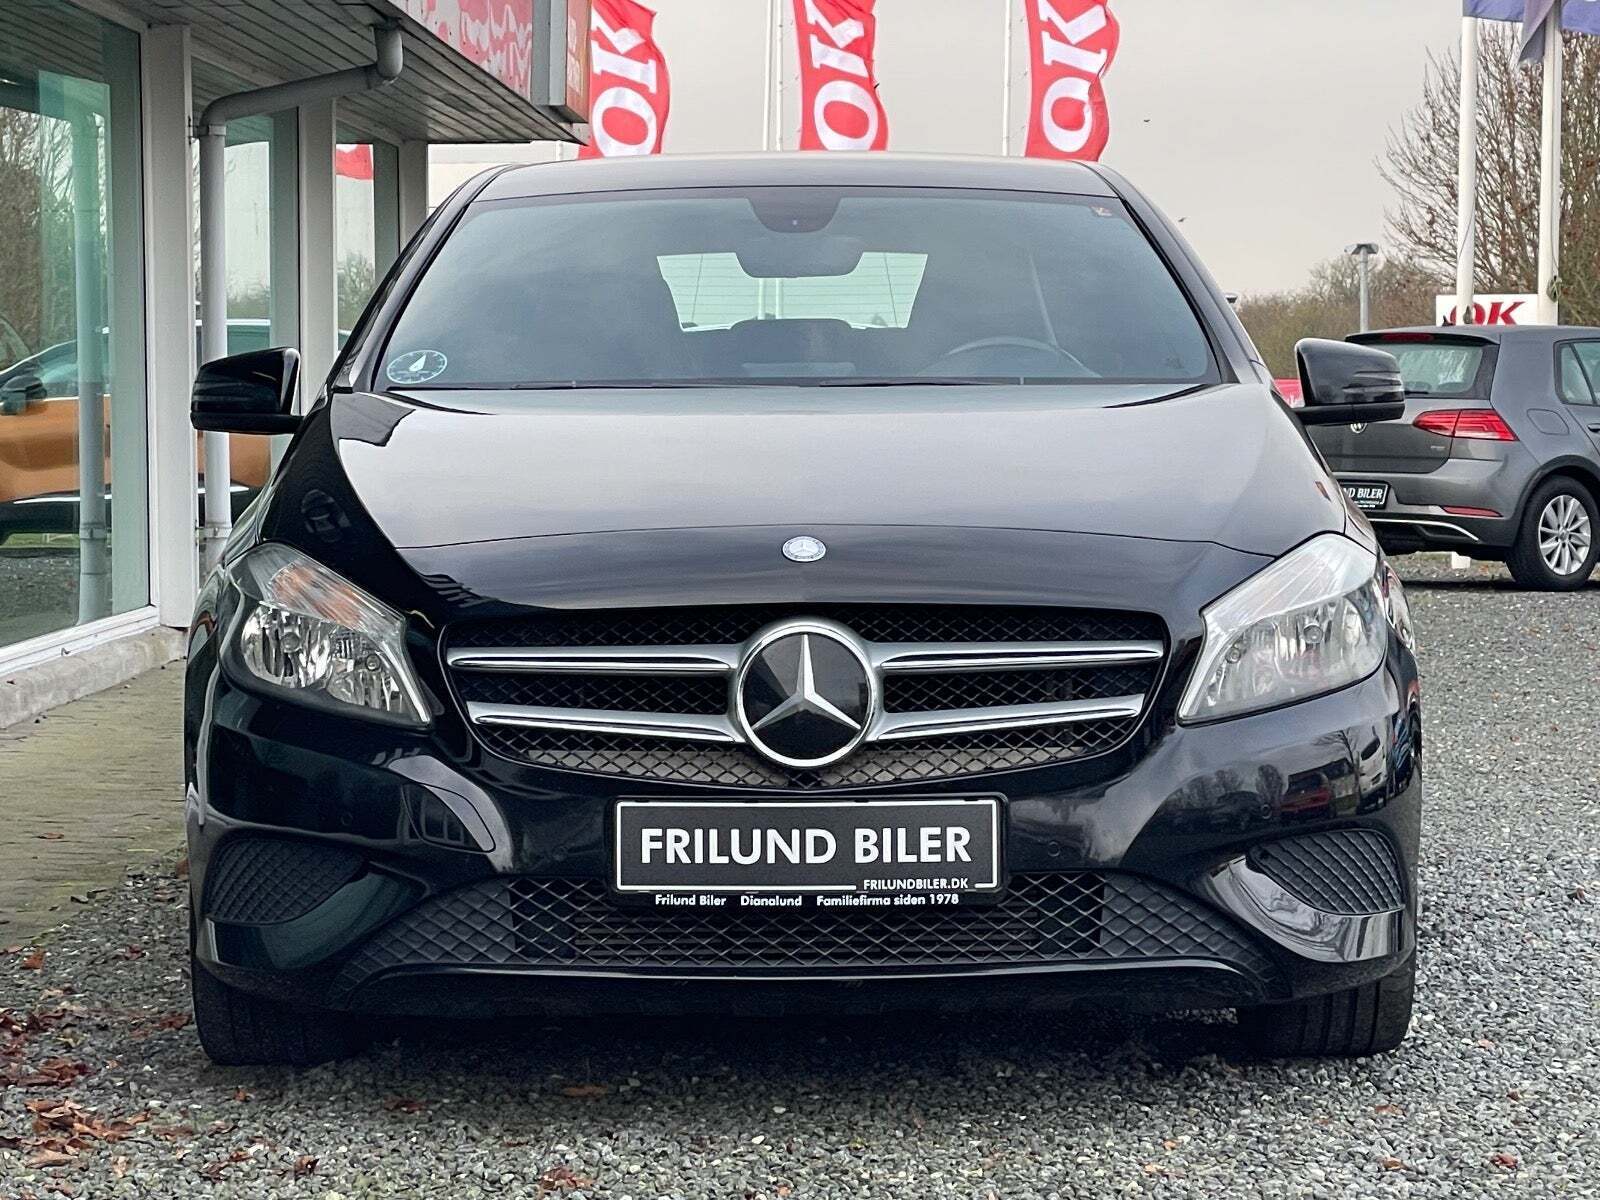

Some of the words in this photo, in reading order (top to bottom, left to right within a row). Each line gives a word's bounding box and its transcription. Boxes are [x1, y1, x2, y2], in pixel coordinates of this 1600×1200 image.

[591, 6, 658, 157] OK
[804, 0, 879, 150] OK
[1037, 0, 1107, 153] OK
[1357, 487, 1383, 499] BILER
[641, 828, 837, 865] FRILUND
[855, 827, 972, 863] BILER
[655, 894, 696, 906] Frilund
[699, 894, 727, 906] Biler
[740, 895, 802, 907] Dianalund
[816, 894, 891, 906] Familiefirma
[894, 893, 926, 905] siden
[929, 893, 959, 905] 1978
[863, 878, 968, 890] FRILUNDBILER.DK
